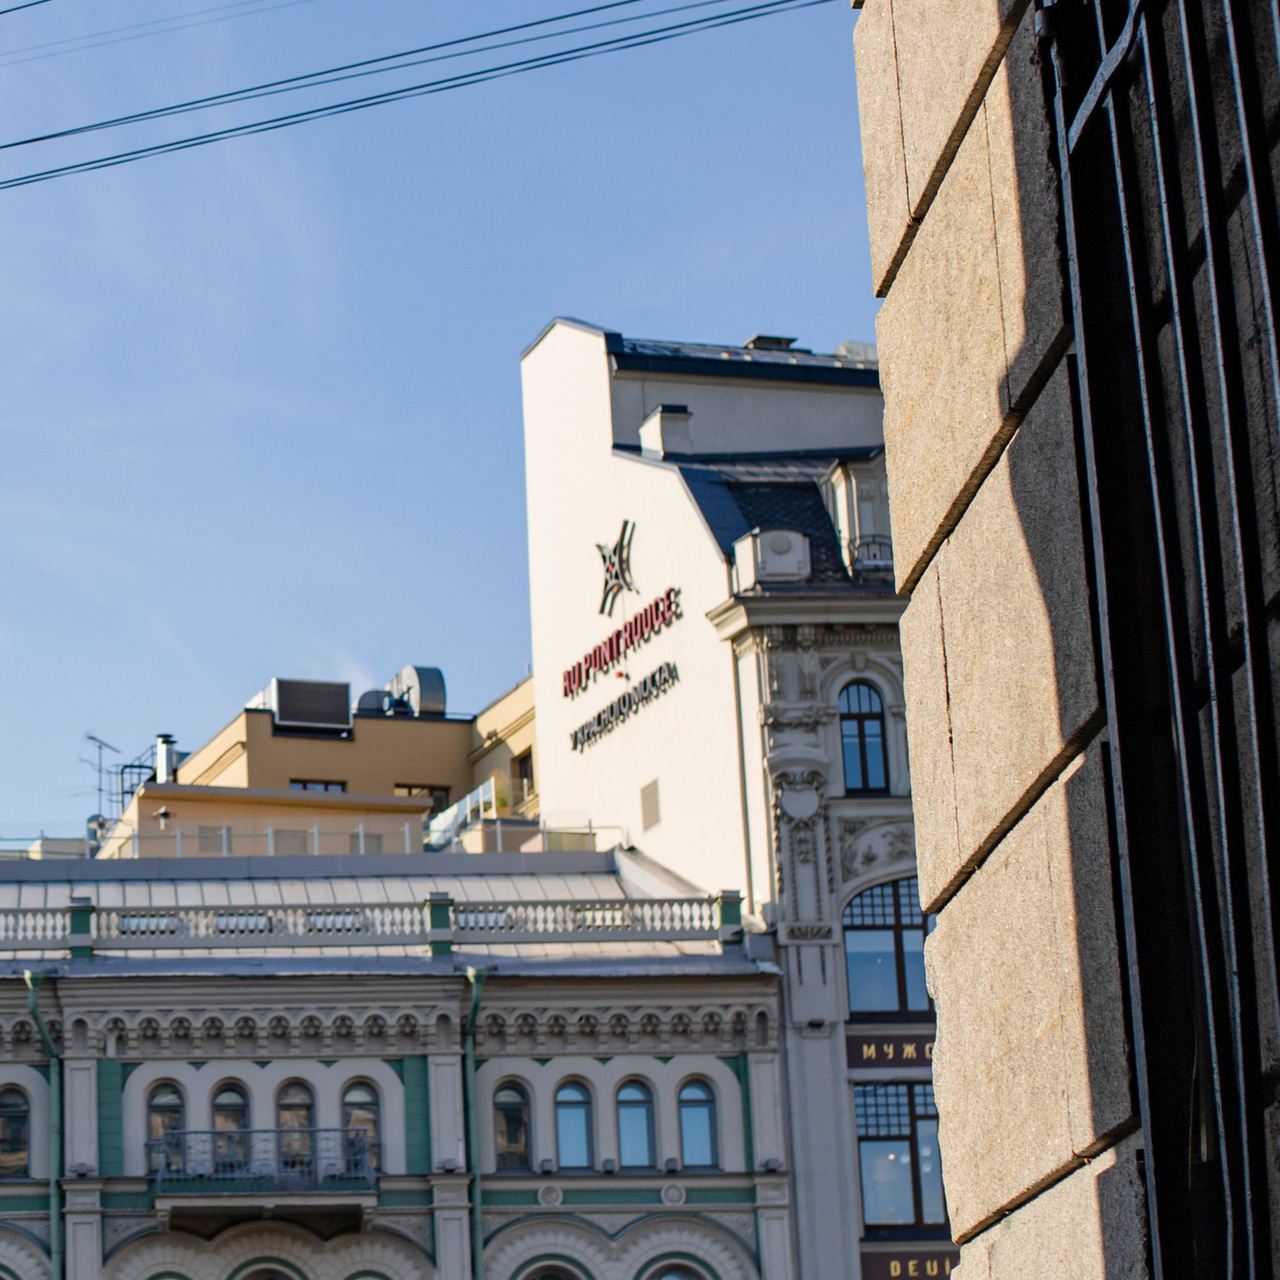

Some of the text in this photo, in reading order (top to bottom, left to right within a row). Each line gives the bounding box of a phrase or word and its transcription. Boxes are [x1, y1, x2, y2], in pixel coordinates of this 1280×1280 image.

[563, 587, 676, 697] AU PONT ROUGE
[889, 1257, 960, 1277] DEUI
